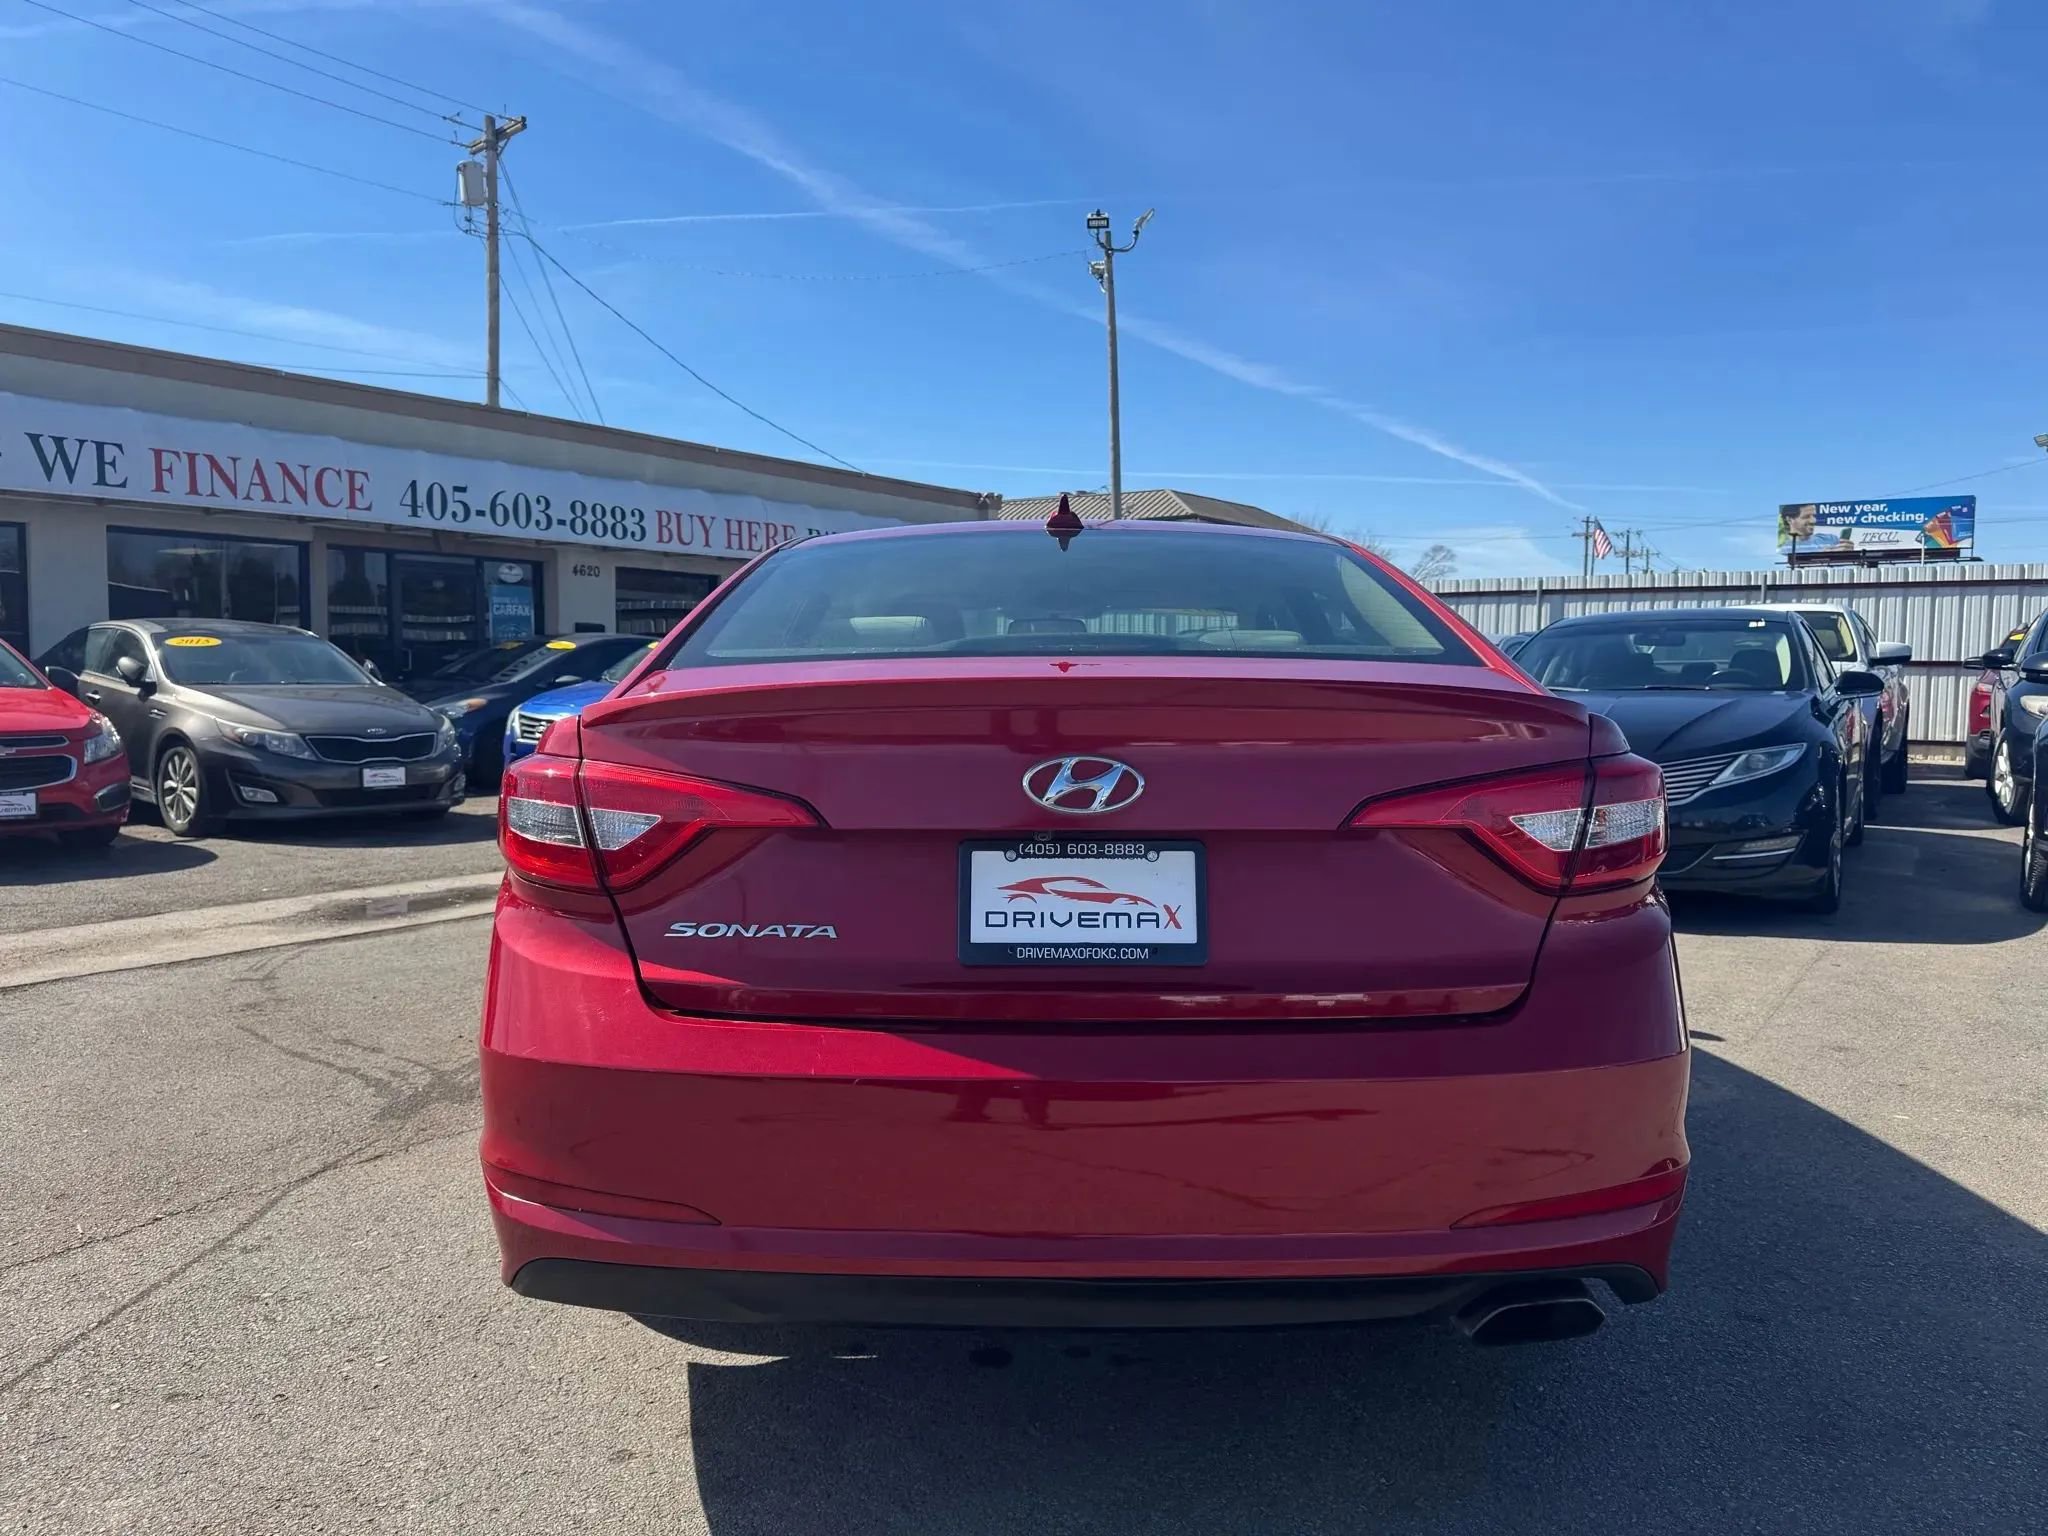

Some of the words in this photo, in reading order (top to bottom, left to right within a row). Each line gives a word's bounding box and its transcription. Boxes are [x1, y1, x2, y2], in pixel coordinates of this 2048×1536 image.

[24, 431, 128, 488] WE
[149, 447, 373, 511] FINANCE
[400, 479, 647, 542] 405-603-8883
[656, 510, 716, 548] BUY
[1819, 504, 1851, 514] New
[1854, 502, 1889, 514] year,
[1826, 515, 1857, 525] new
[1860, 512, 1929, 525] checking.
[572, 564, 600, 578] 4620
[1019, 843, 1061, 855] (405)
[1067, 843, 1145, 855] 603-8883
[985, 904, 1183, 929] DRIVEMAX
[664, 922, 838, 939] SONATA
[1016, 947, 1149, 960] DRIVEMAXOFOKC.COM
